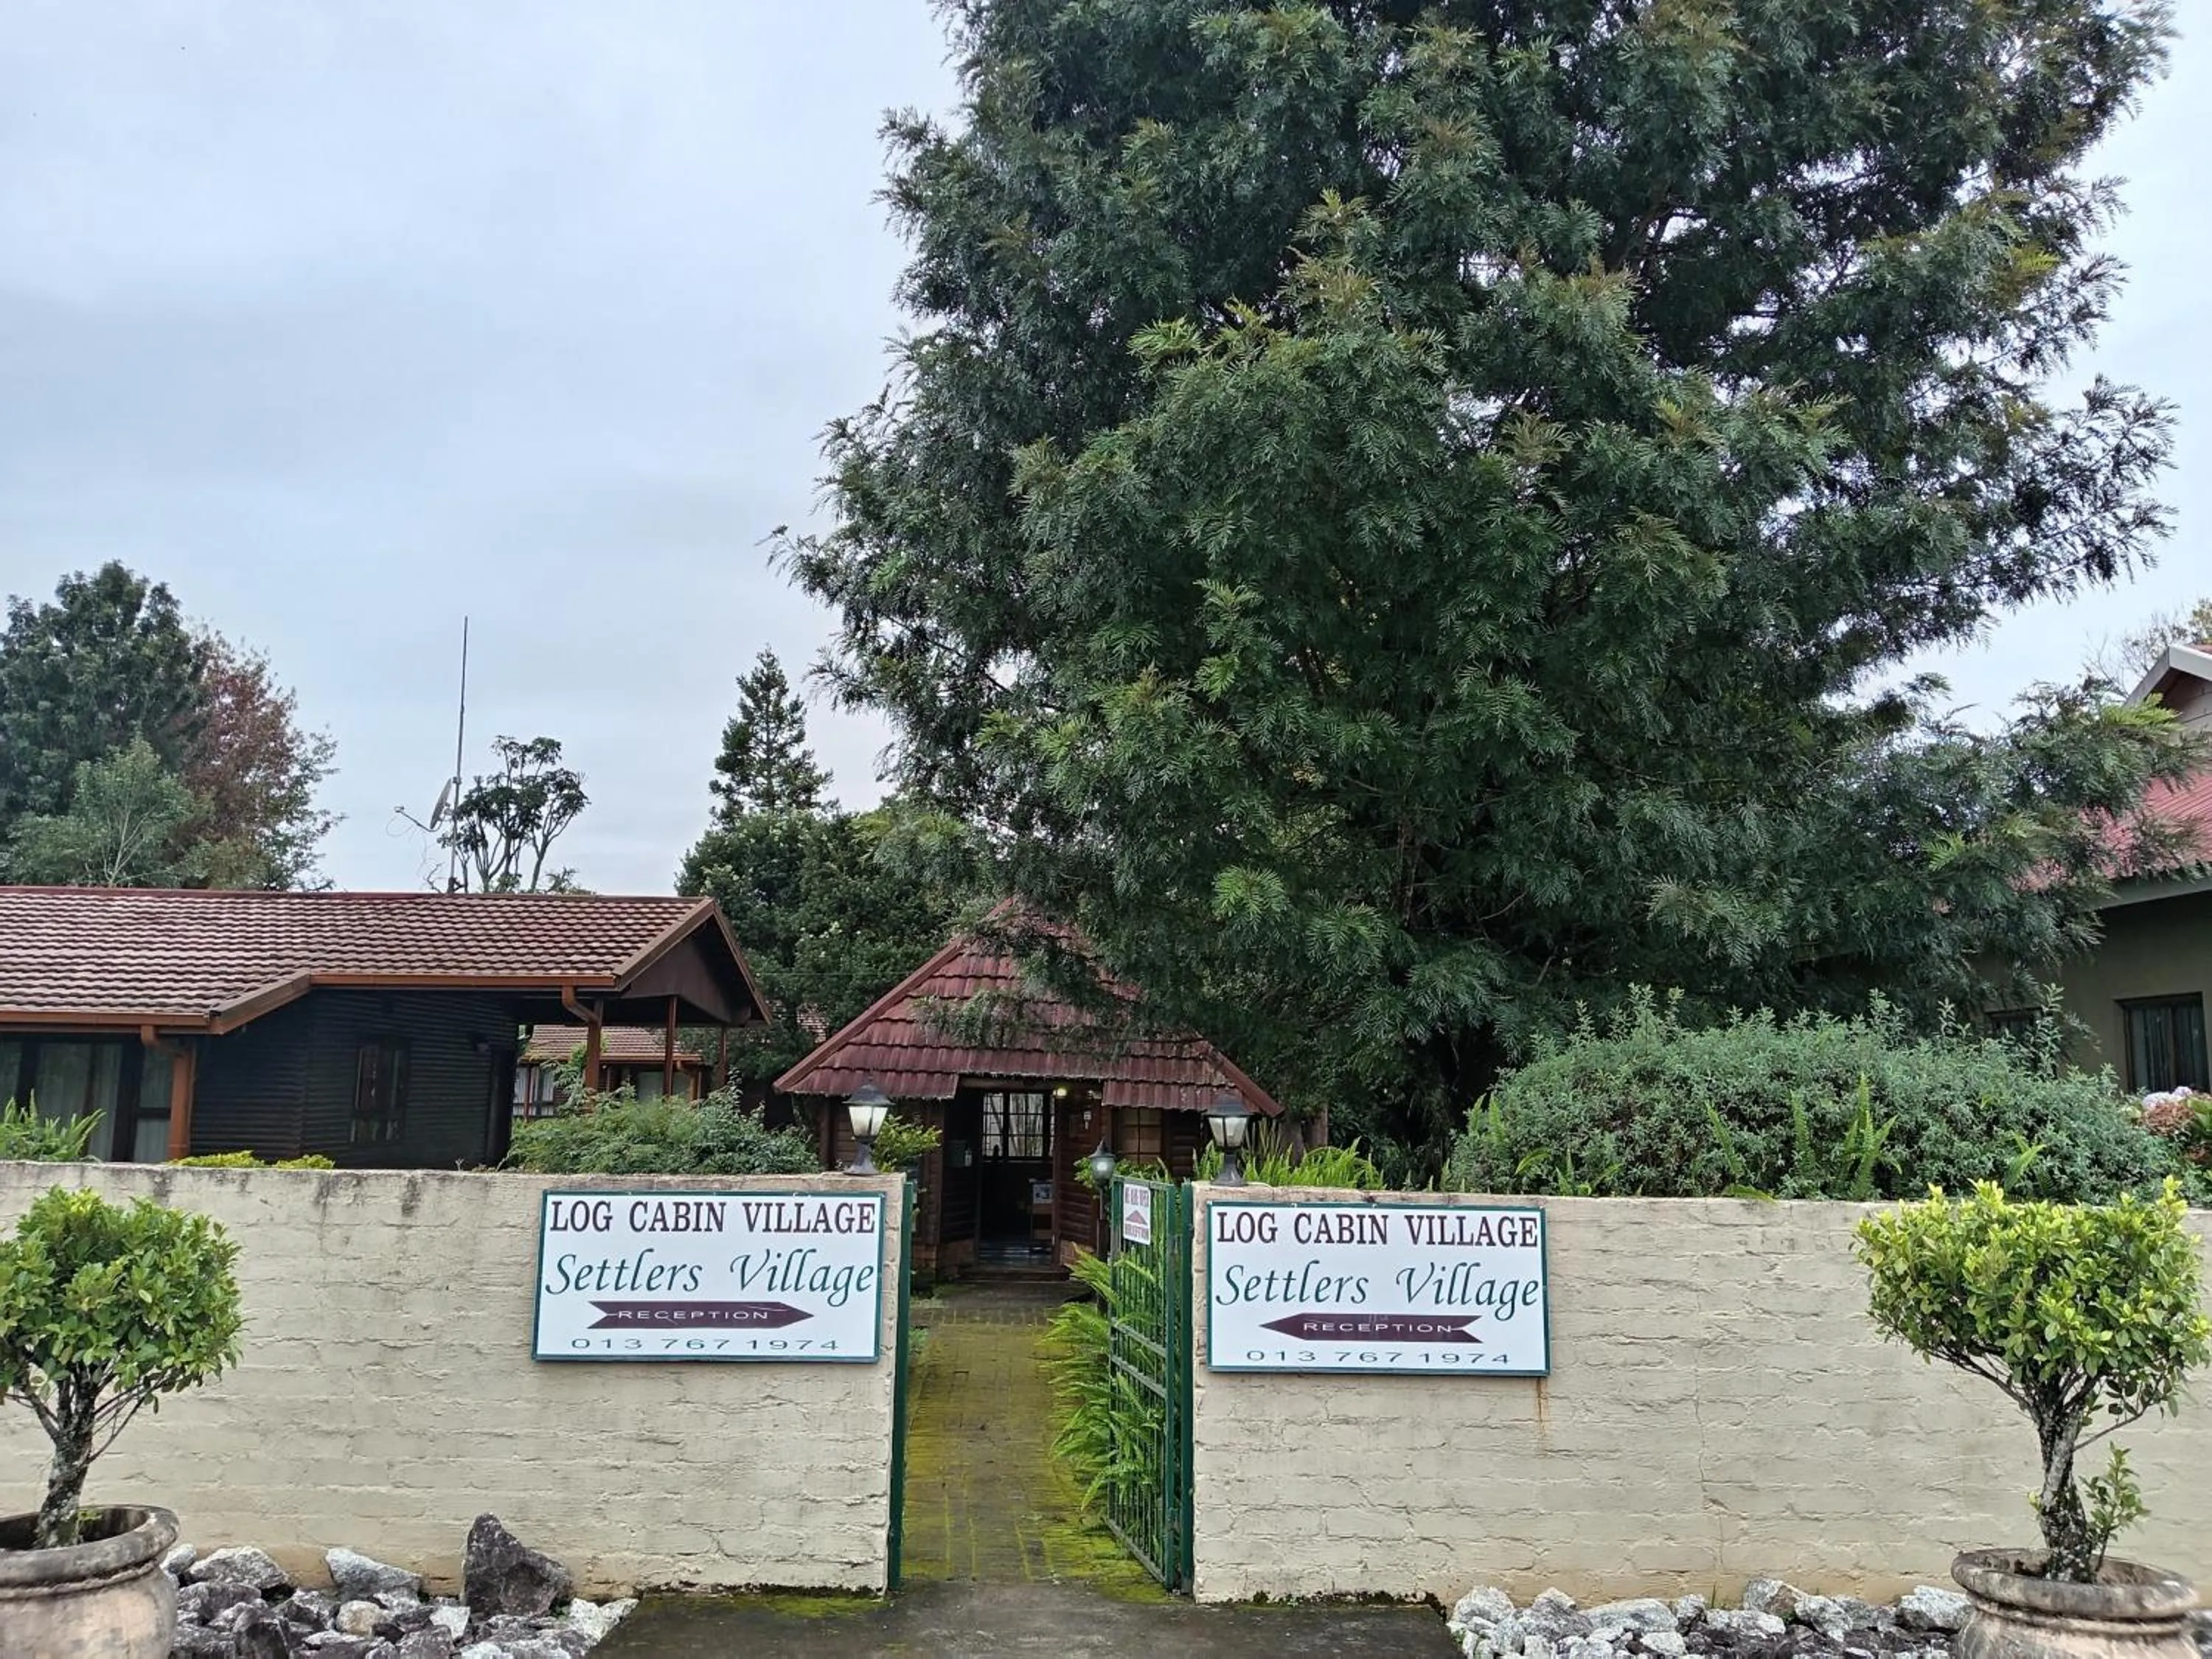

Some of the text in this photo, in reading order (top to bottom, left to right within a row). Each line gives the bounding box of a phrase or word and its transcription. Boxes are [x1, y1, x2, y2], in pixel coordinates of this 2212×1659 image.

[549, 1200, 875, 1234] LOG CABIN VILLAGE
[1217, 1211, 1538, 1248] LOG CABIN VILLAGE
[545, 1248, 874, 1307] Settlers Village
[1215, 1259, 1539, 1321] Settlers Village
[618, 1310, 768, 1320] RECEPTION
[1303, 1322, 1452, 1333] RECEPTION
[571, 1338, 839, 1351] 013 767 1974
[1246, 1350, 1510, 1365] 013 767 1974
